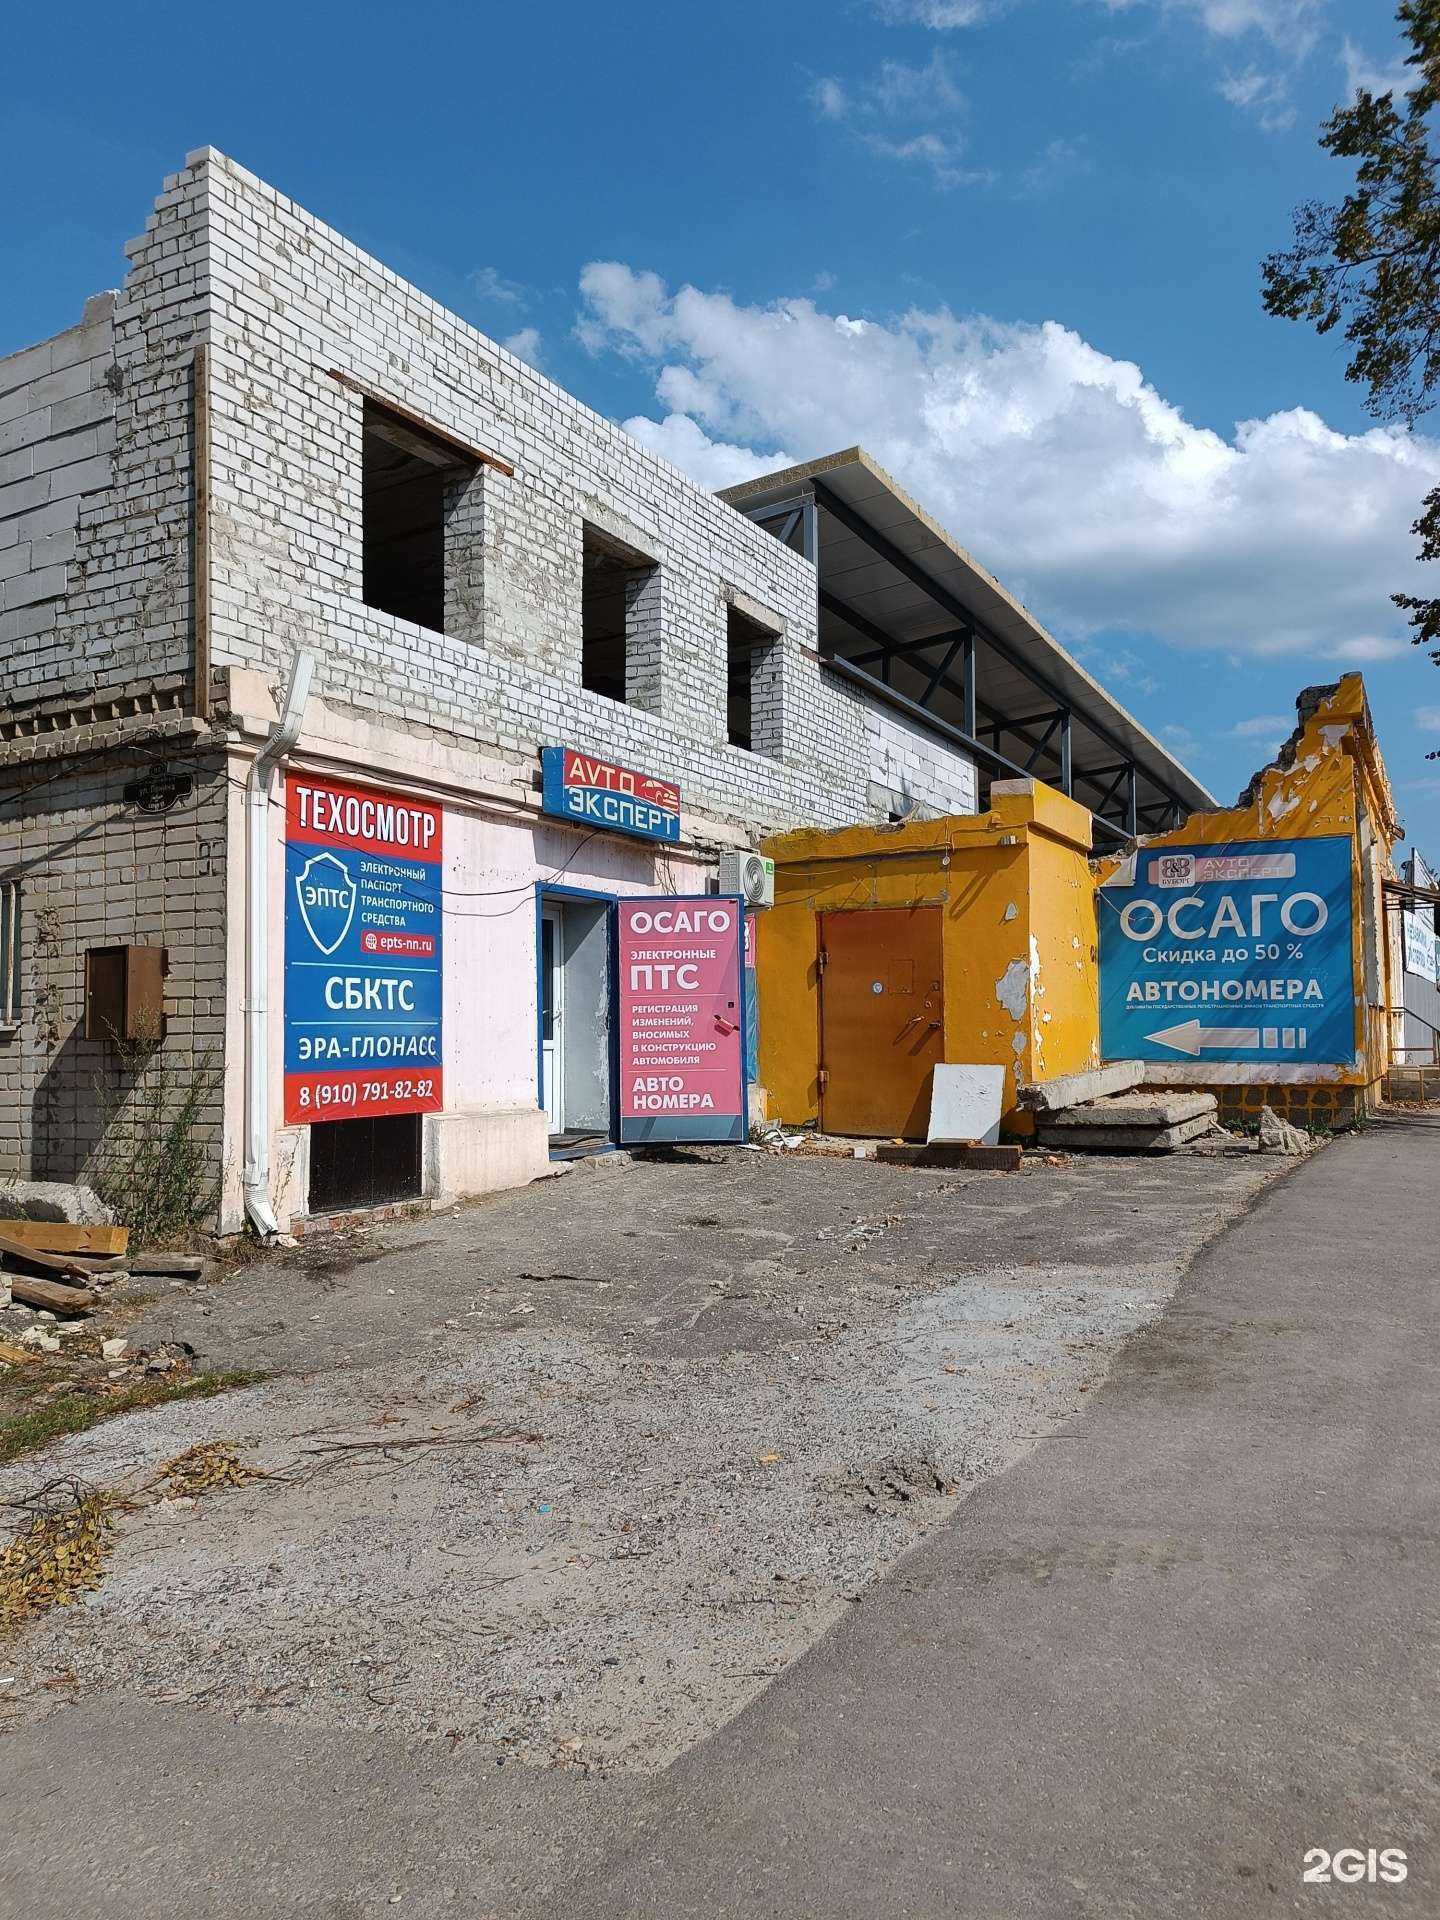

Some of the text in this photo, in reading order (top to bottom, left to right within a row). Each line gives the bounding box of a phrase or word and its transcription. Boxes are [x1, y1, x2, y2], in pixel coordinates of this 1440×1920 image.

[296, 786, 436, 849] ТЕХОСМОТР
[568, 786, 675, 835] ЭКСПЕРТ
[360, 861, 426, 881] ЭЛЕКТРОННЫЙ
[1204, 867, 1282, 880] ЭКСПЕРТ
[360, 879, 402, 893] ПАСПОРТ
[305, 886, 350, 909] ЭПТС
[360, 895, 434, 914] ТРАНСПОРТНОГО
[361, 912, 406, 927] СРЕДСТВА
[630, 910, 731, 934] ОСАГО
[1120, 892, 1328, 941] ОСАГО
[380, 936, 432, 951] epts-nn.ru
[1142, 943, 1304, 963] Скидка до 50 %
[630, 950, 717, 960] ЭЛЕКТРОННЫЕ
[630, 964, 701, 990] ПТС
[324, 976, 415, 1011] СБКТС
[1126, 979, 1324, 1002] АВТОНОМЕРА
[632, 1004, 698, 1014] РЕГИСТРАЦИЯ
[632, 1016, 694, 1027] ИЗМЕНЕНИЙ,
[632, 1030, 690, 1040] ВНОСИМЫХ
[298, 1036, 437, 1060] ЭРА-ГЛОНАСС
[632, 1042, 717, 1053] В КОНСТРУКЦИЮ
[632, 1056, 700, 1066] АВТОМОБИЛЯ
[300, 1079, 433, 1109] 8 (910) 791-82-82
[632, 1077, 684, 1092] АВТО
[633, 1094, 714, 1110] НОМЕРА
